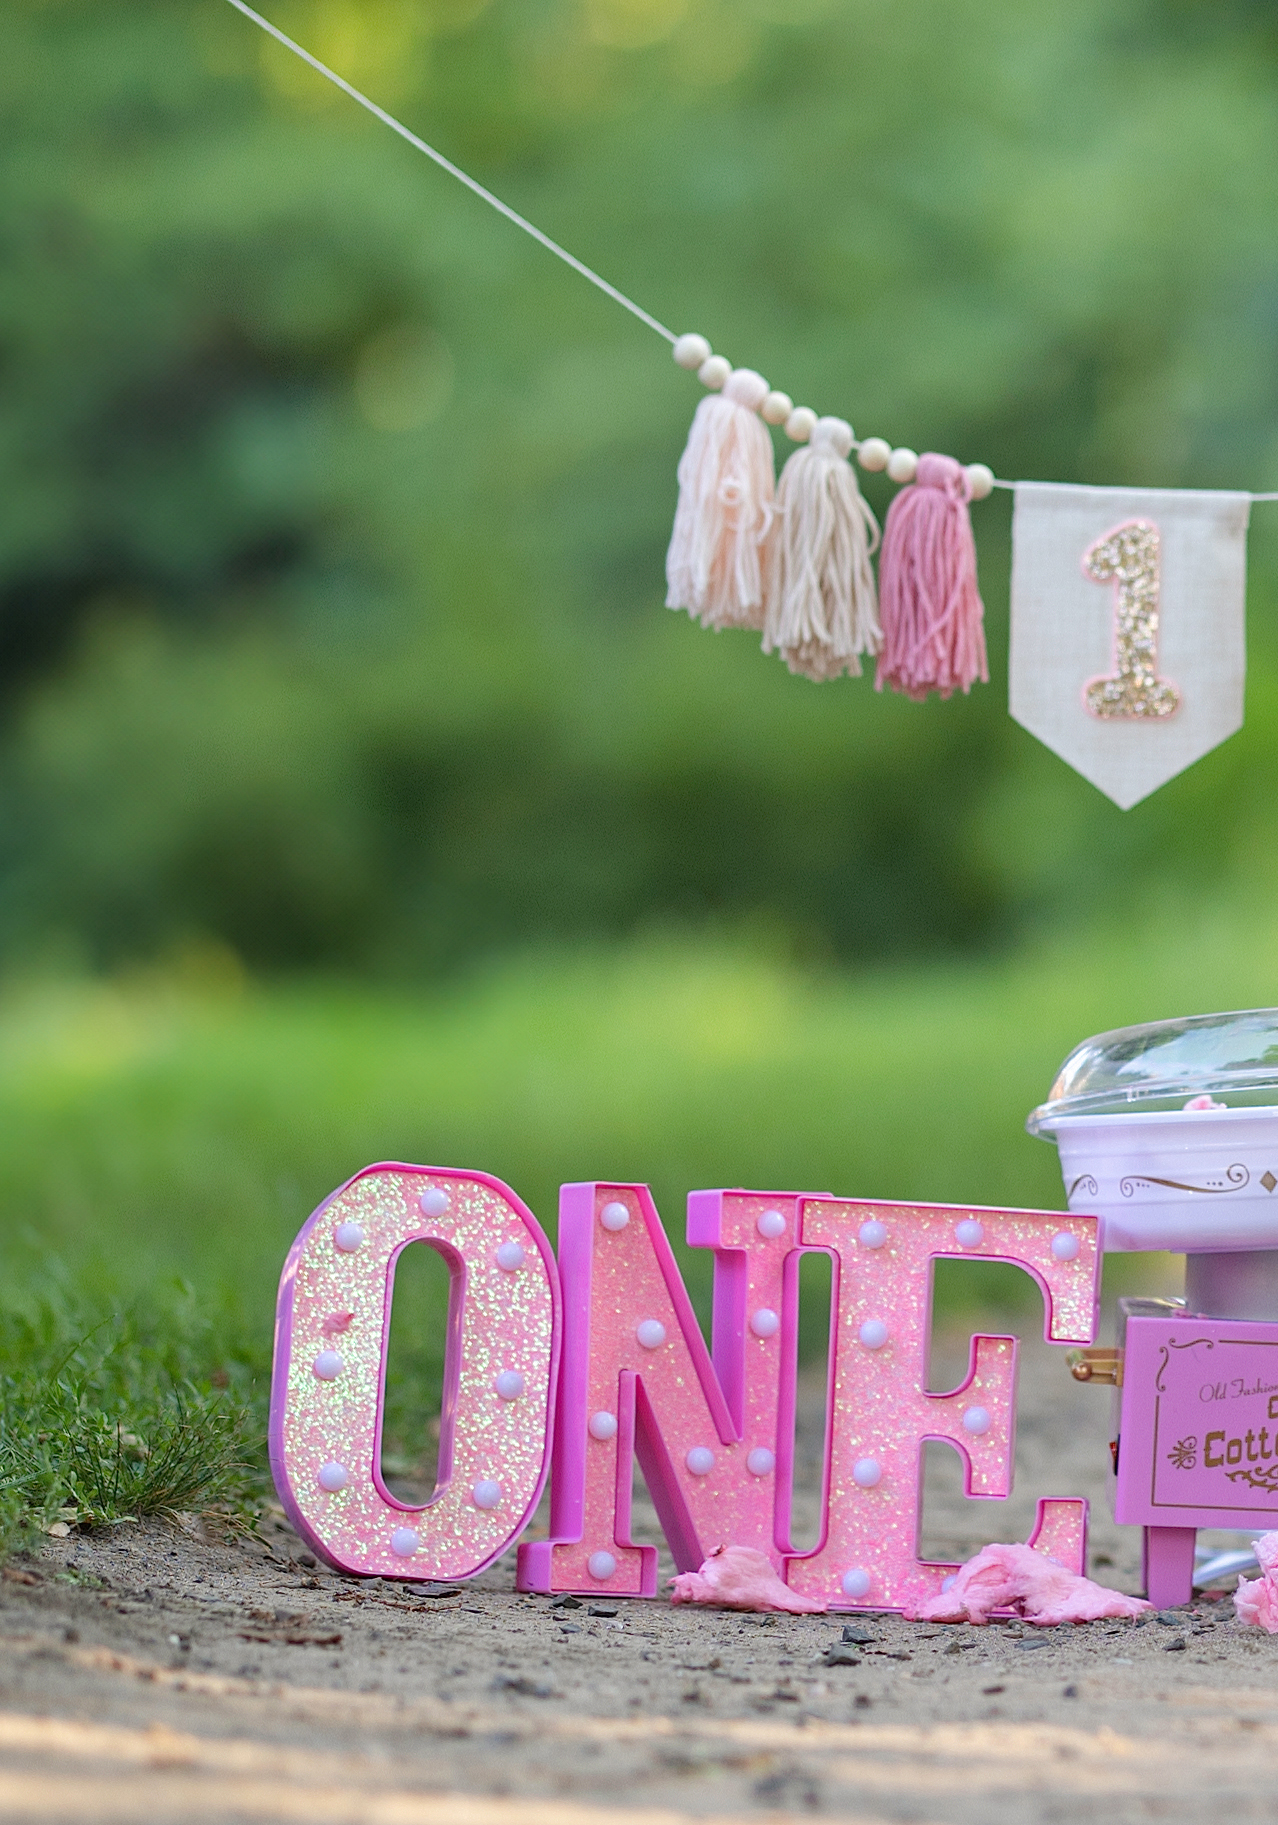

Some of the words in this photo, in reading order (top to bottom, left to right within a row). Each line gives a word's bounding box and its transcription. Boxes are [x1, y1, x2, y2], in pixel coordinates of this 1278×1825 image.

[1081, 517, 1182, 721] 1
[270, 1160, 1103, 1615] ONE
[1199, 1381, 1228, 1403] Old
